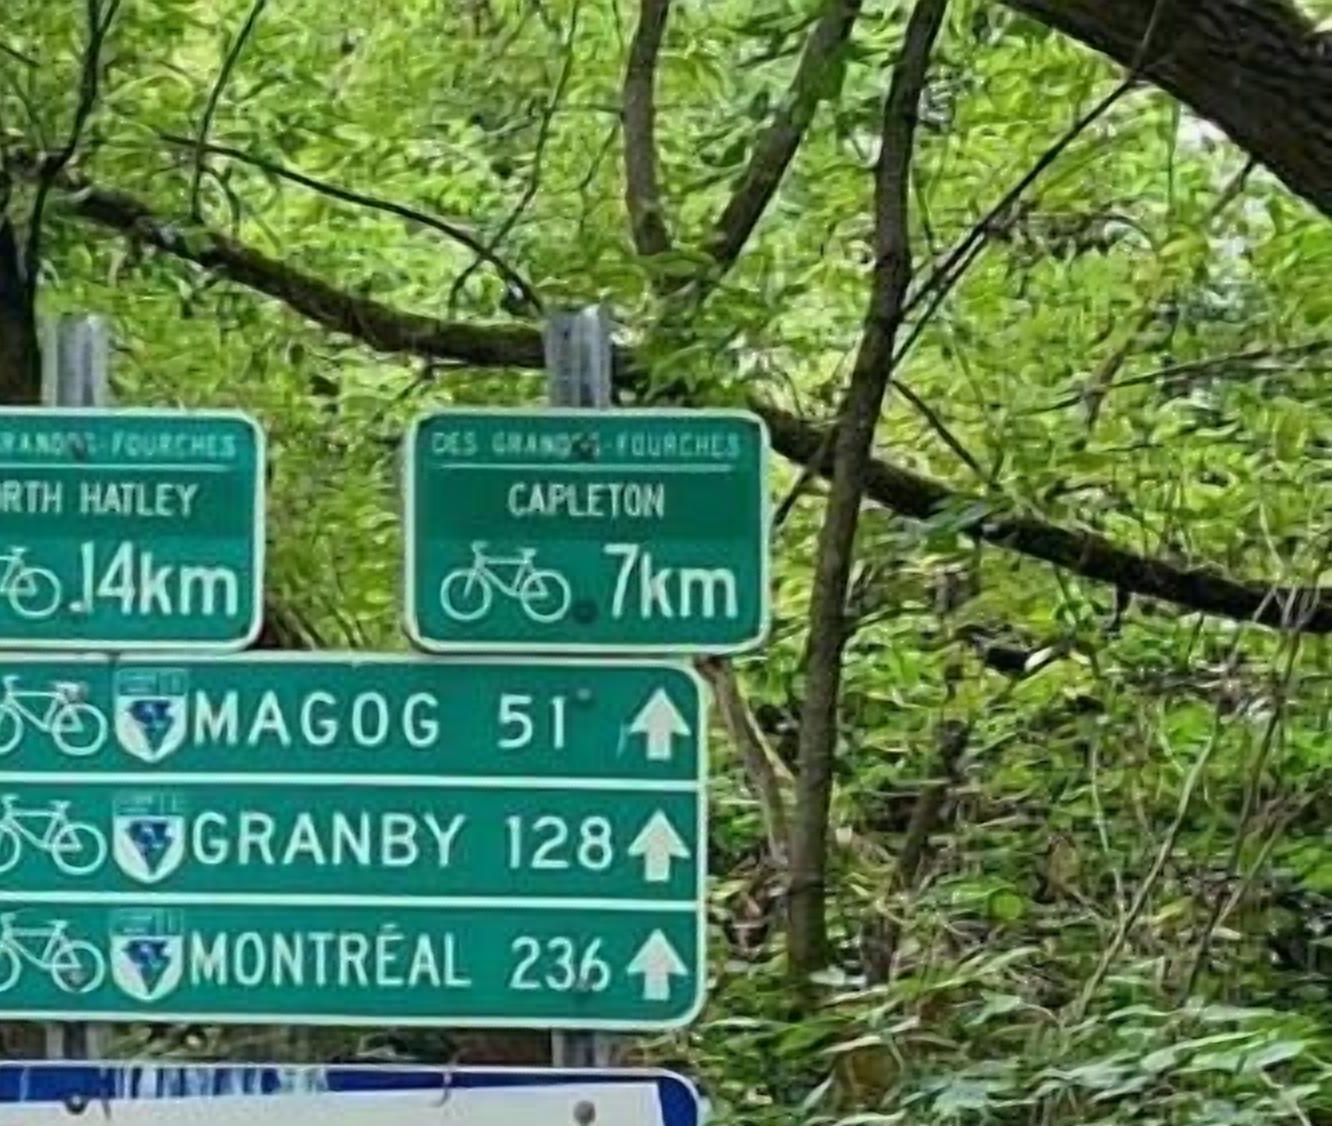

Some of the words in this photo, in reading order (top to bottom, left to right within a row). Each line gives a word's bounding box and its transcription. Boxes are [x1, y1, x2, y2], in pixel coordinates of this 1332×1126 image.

[432, 431, 477, 455] DES
[80, 482, 198, 518] HATLEY
[508, 482, 665, 518] CAPLETON
[603, 542, 738, 619] 7km
[193, 688, 440, 749] MAGOG
[496, 692, 568, 750] 51
[191, 810, 466, 868] GRANBY
[506, 814, 614, 871] 128
[188, 922, 472, 988] MONTRÉAL
[509, 935, 612, 992] 236
